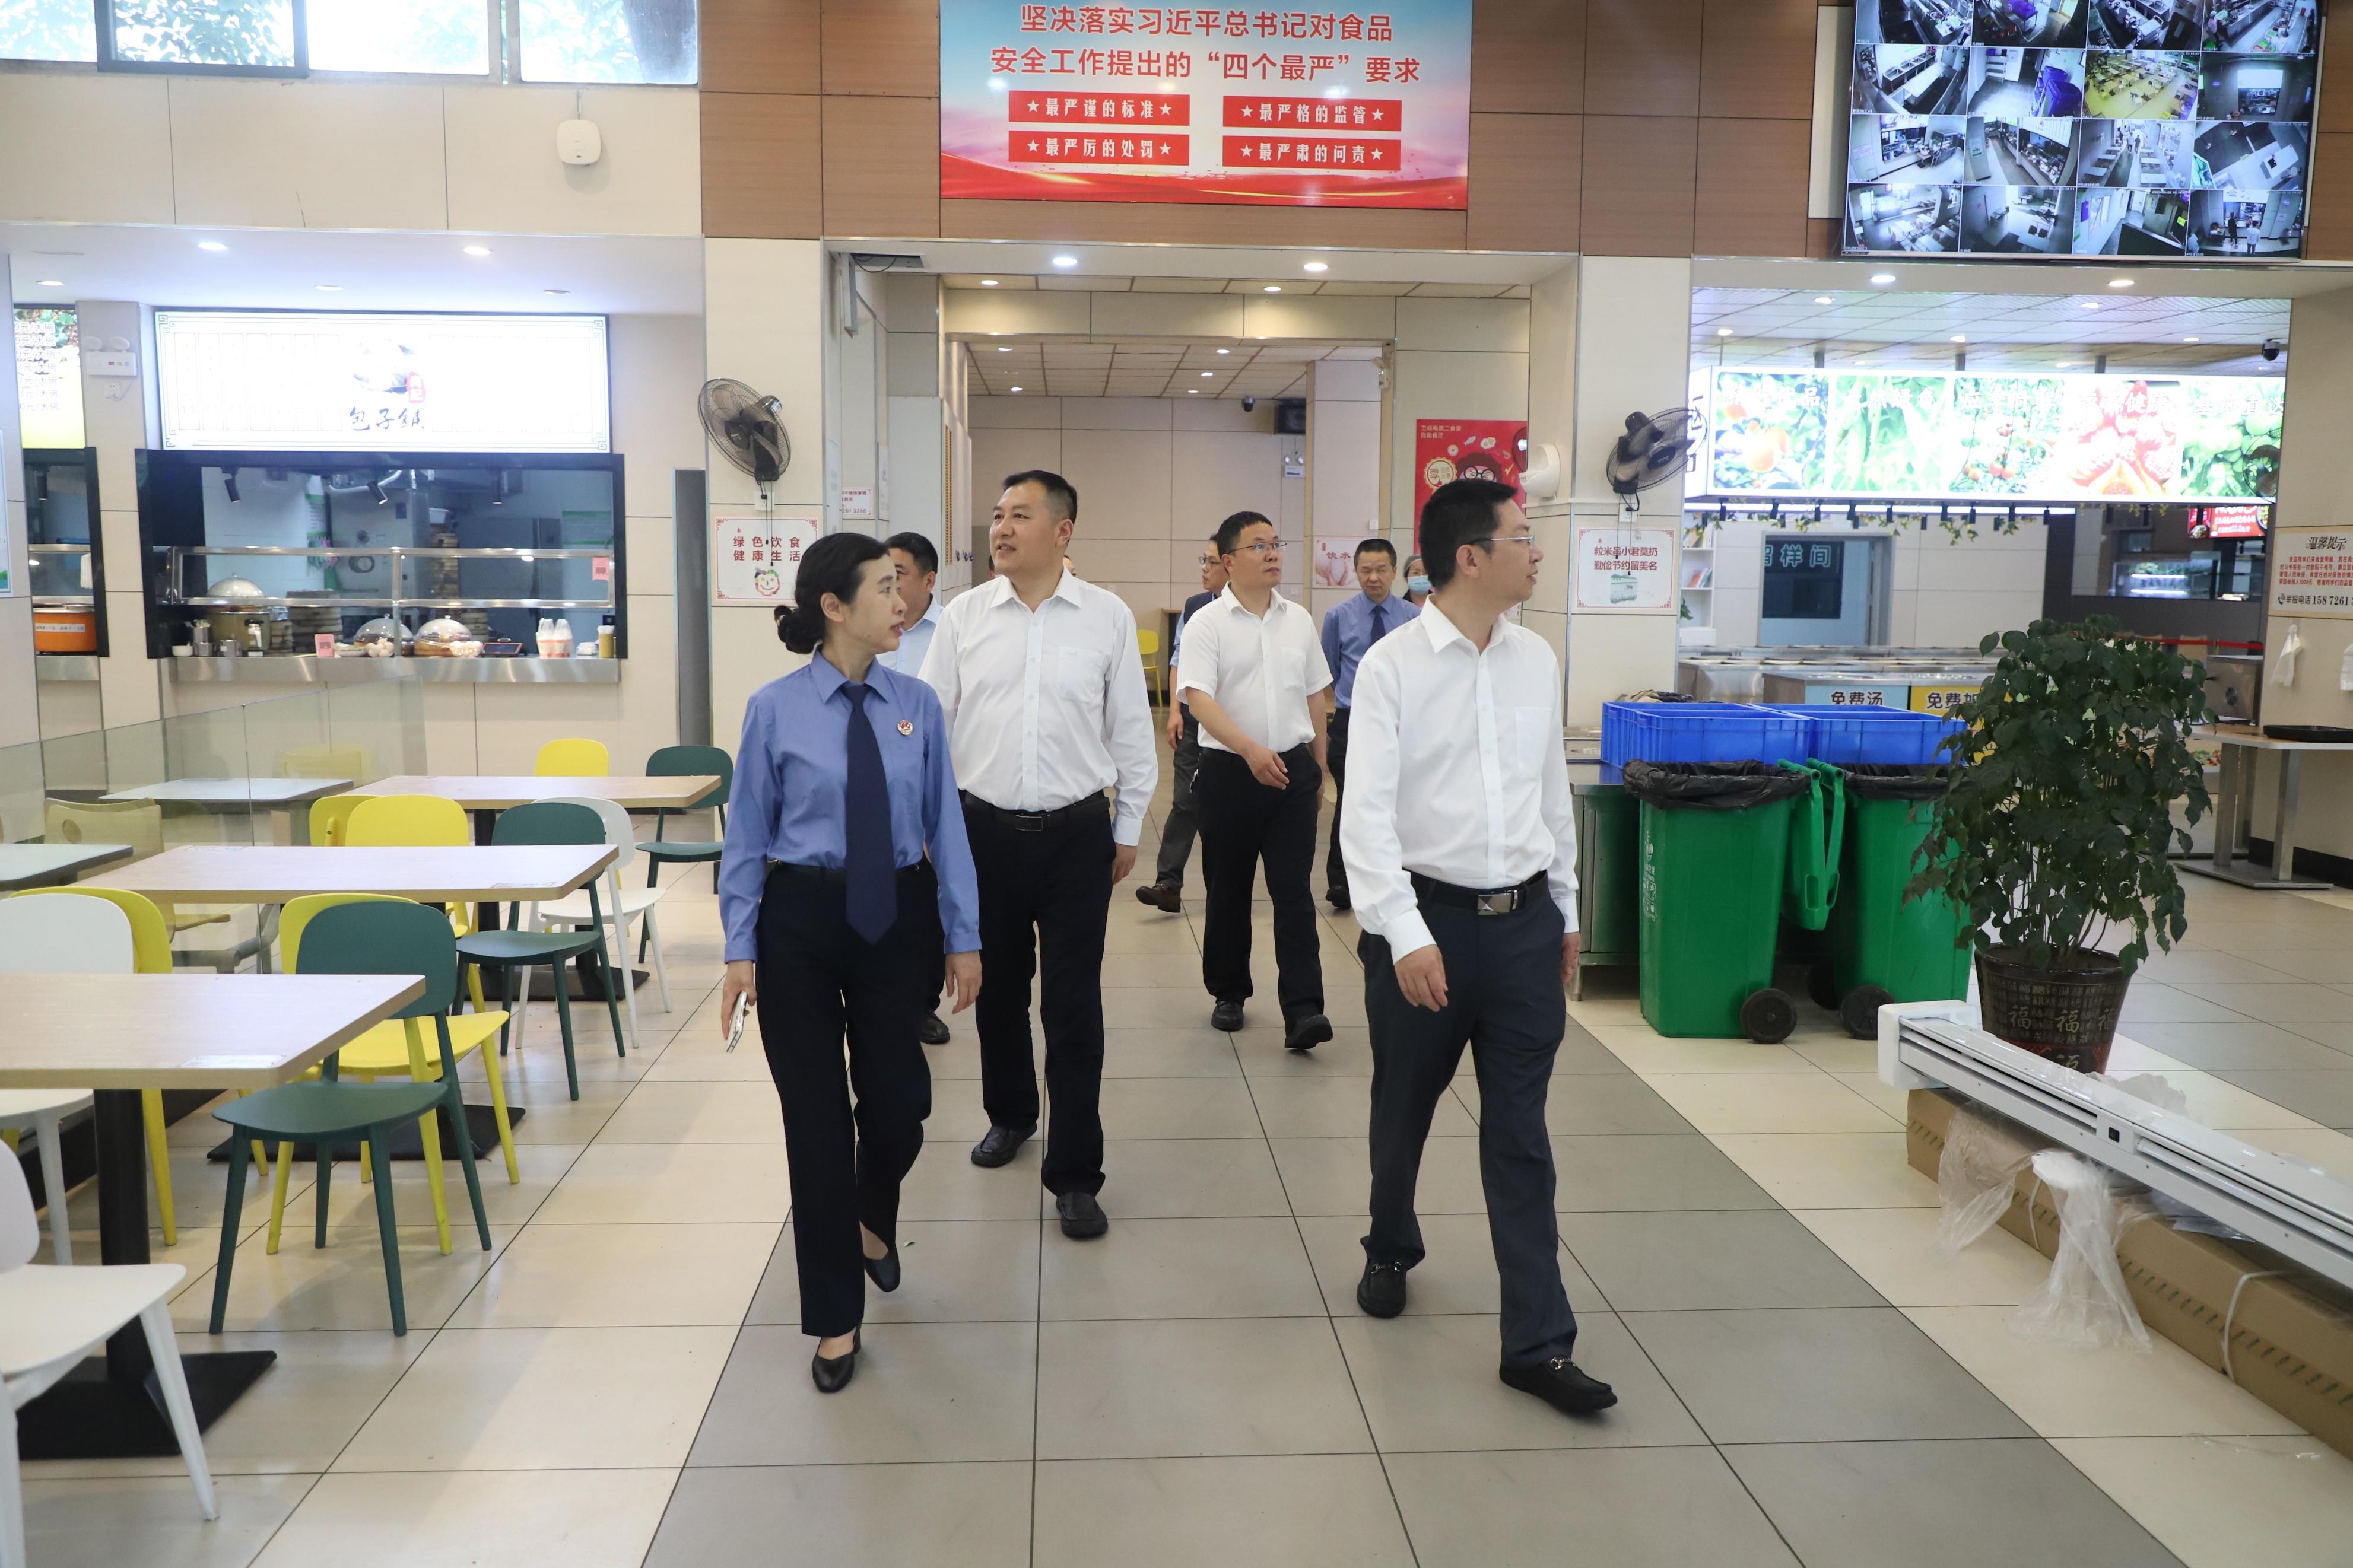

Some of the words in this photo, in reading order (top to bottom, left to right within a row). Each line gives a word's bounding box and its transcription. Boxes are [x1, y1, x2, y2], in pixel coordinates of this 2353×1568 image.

[1020, 4, 1393, 42] 坚决落实习近平总书记对食品
[990, 47, 1420, 84] 安全工作提出的“四个最严”要求
[1045, 98, 1155, 119] 最严谨的标准
[1259, 103, 1367, 125] 最严格的监管
[1045, 138, 1154, 159] 最严厉的处罚
[1258, 143, 1366, 164] 最严肃的问责
[733, 536, 800, 548] 绿色饮食
[2308, 536, 2347, 551] 温馨提示
[733, 550, 801, 561] 健康生活
[1326, 551, 1355, 559] 饮水
[1594, 546, 1658, 556] 粒米虽小君莫扔
[1594, 561, 1657, 570] 勤俭节约留美名
[2286, 594, 2311, 605] 举报电话
[2313, 596, 2327, 605] 158
[2329, 596, 2348, 606] 7261
[1831, 691, 1883, 705] 免费汤
[2055, 1010, 2079, 1033] 福
